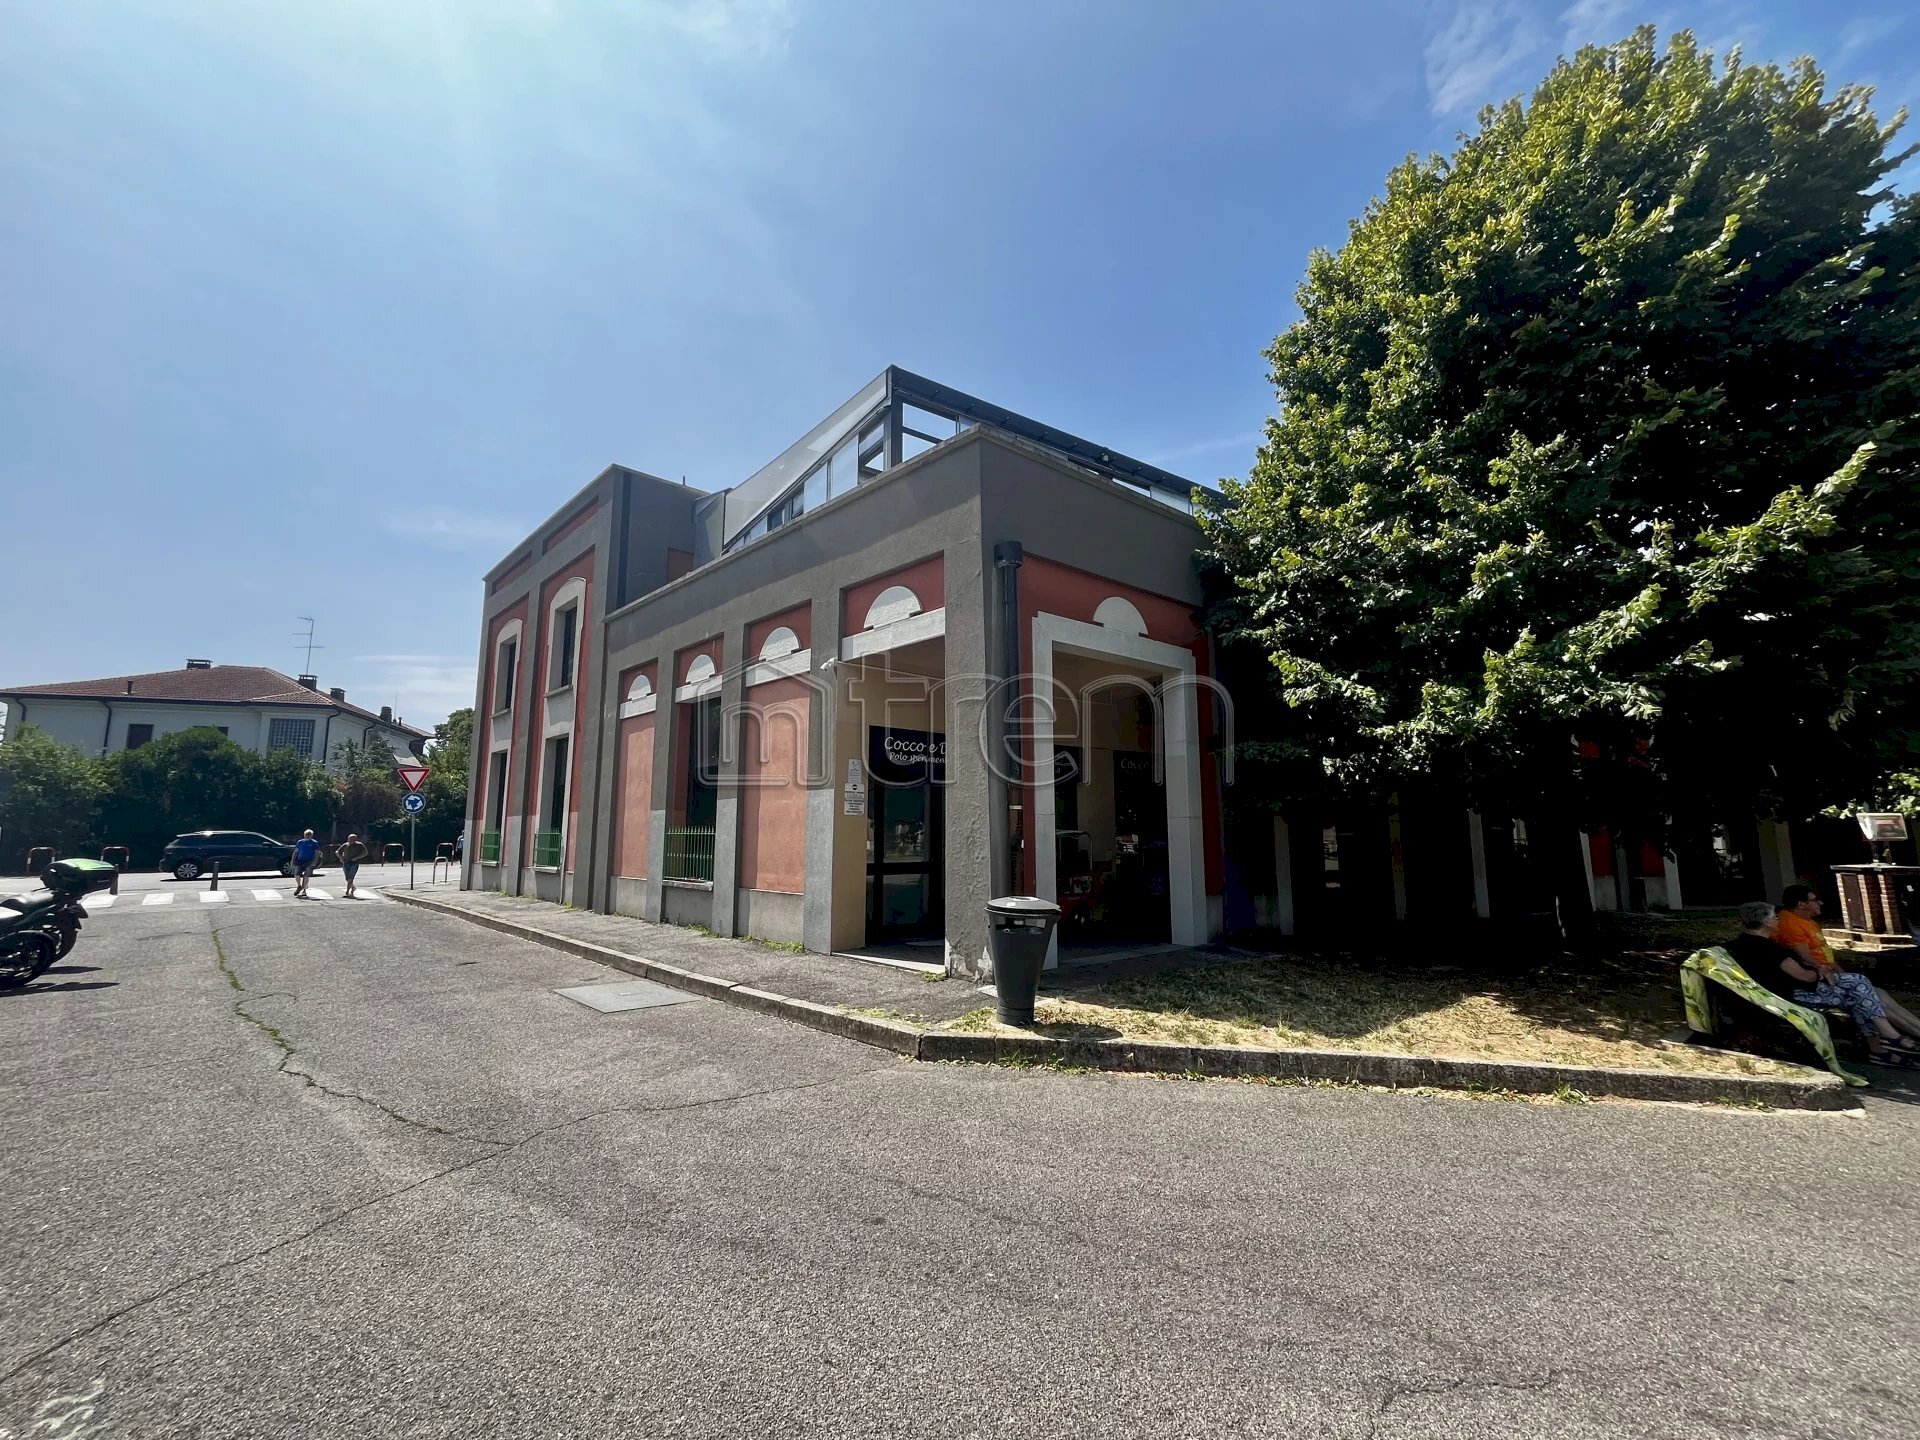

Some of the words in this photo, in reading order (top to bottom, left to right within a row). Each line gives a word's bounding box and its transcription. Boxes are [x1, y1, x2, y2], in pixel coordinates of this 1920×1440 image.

[884, 736, 927, 752] Cocco
[929, 743, 938, 753] e
[889, 751, 908, 761] Polo
[910, 754, 945, 764] sperimen
